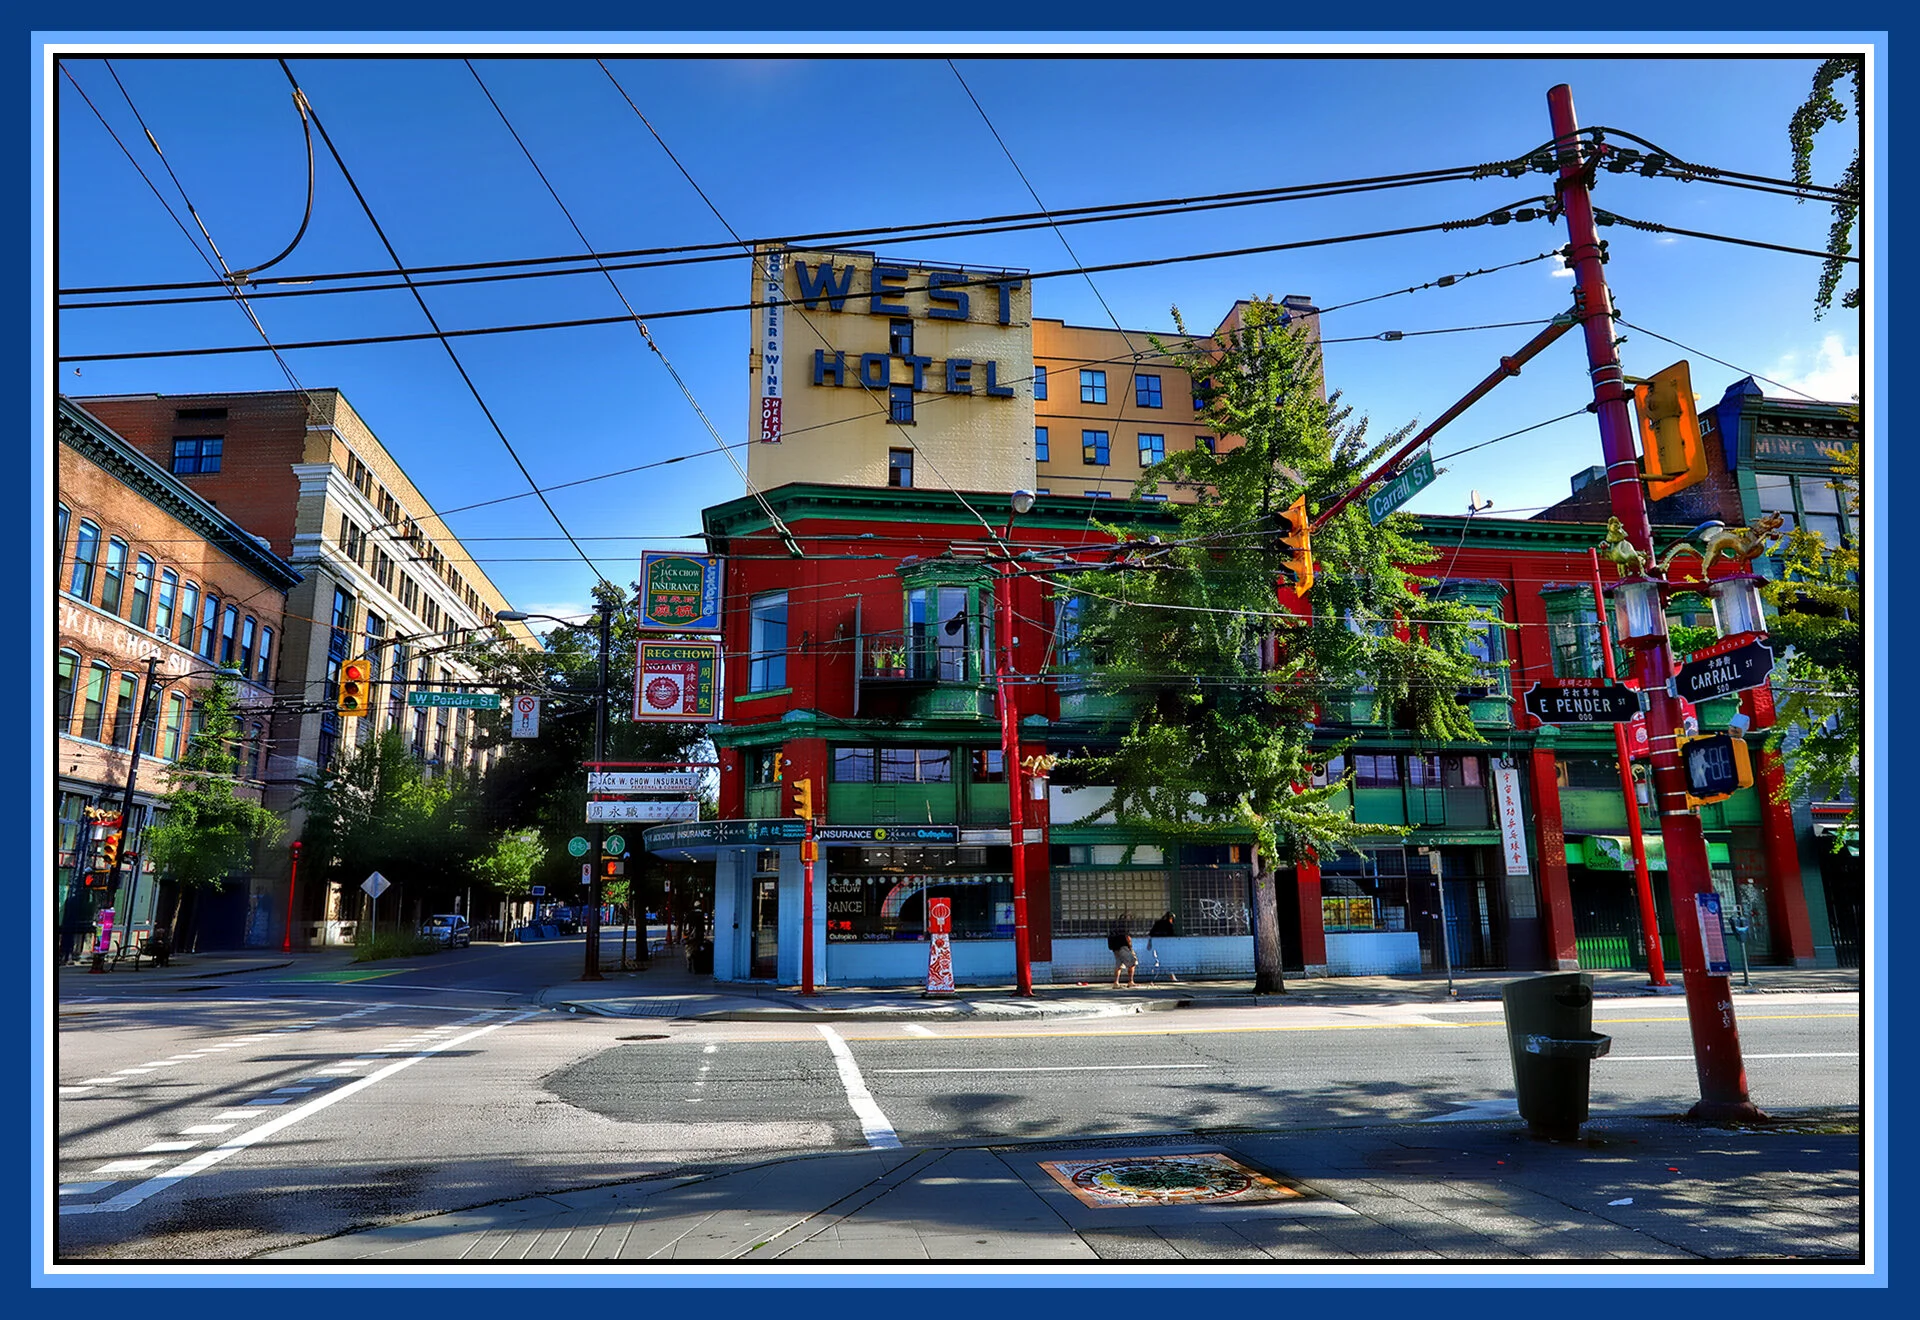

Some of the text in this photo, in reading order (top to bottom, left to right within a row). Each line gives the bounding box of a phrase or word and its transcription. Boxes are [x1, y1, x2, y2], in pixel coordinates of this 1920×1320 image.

[794, 261, 1022, 325] WEST
[768, 296, 777, 336] BEER
[768, 341, 777, 351] &
[765, 354, 779, 396] WINE
[814, 349, 1014, 397] HOTEL
[762, 398, 771, 440] SOLD
[1755, 437, 1805, 455] MING
[1374, 462, 1429, 516] Carrall St
[660, 568, 700, 577] JACK CHOW
[651, 582, 700, 592] INSURANCE
[112, 630, 162, 660] CHOP
[1694, 639, 1745, 659] SILK ROAD
[647, 649, 711, 659] REG CHOW
[645, 663, 684, 671] NOTARY
[1691, 659, 1753, 690] CARRALL ST
[1717, 683, 1730, 693] 500
[415, 694, 493, 707] W Pender St
[1540, 698, 1626, 713] E PENDER ST
[1578, 713, 1593, 721] 000
[598, 777, 693, 786] JACK W. CHOW INSURANCE
[677, 830, 711, 840] INSURANCE
[820, 830, 871, 839] INSURANCE
